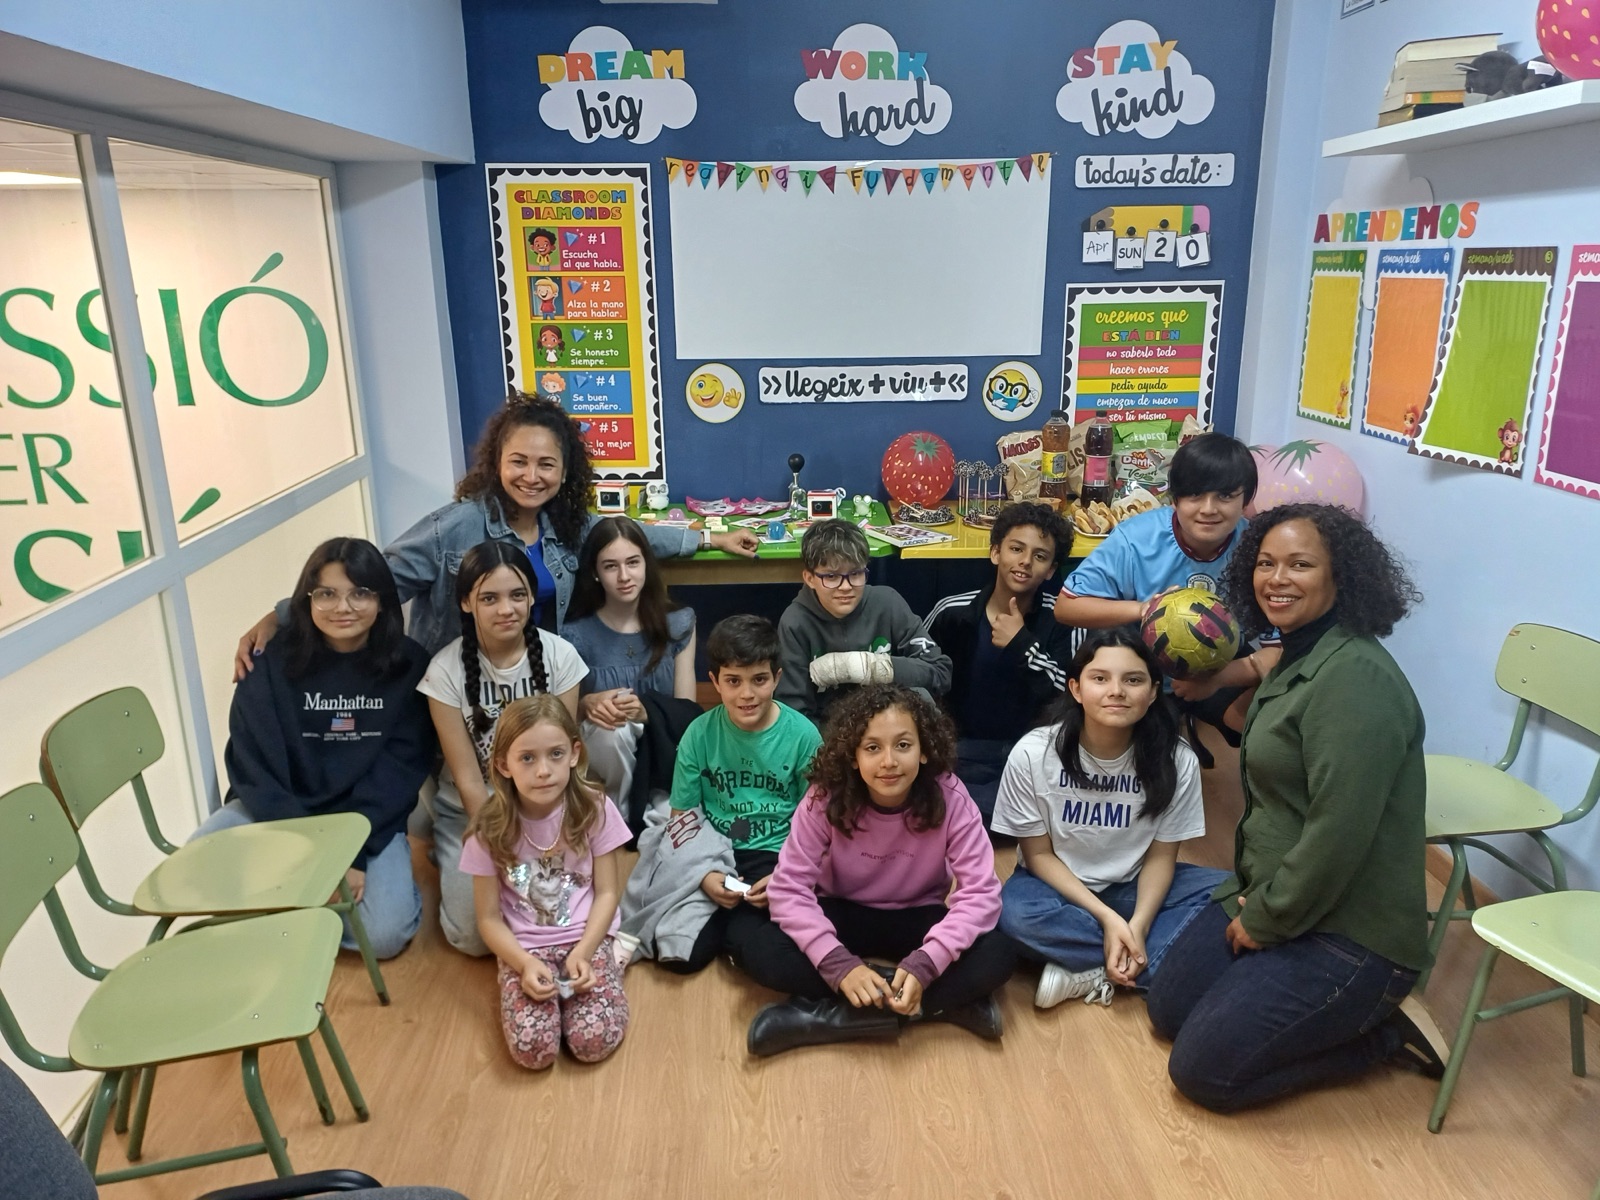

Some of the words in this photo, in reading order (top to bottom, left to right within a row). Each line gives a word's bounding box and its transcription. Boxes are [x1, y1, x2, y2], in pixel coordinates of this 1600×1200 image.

[801, 49, 928, 81] WORK
[1071, 40, 1178, 78] STAY
[537, 50, 685, 84] DREAM
[1091, 66, 1184, 135] kind
[577, 89, 642, 140] big
[838, 77, 935, 142] hard
[667, 162, 788, 188] reading
[1083, 156, 1157, 186] today's
[1160, 154, 1222, 185] date:
[514, 190, 627, 203] CLASSROOM
[521, 206, 622, 220] DIAMONDS
[1313, 201, 1480, 243] APRENDEMOS
[562, 250, 598, 259] Escucha
[1086, 240, 1109, 255] Apr
[1118, 247, 1142, 259] SUN
[1154, 237, 1168, 258] 2
[1185, 239, 1200, 260] 0
[563, 259, 571, 268] al
[575, 261, 589, 270] que
[594, 259, 621, 268] habla.
[567, 300, 587, 308] Alza
[590, 300, 598, 308] la
[567, 311, 588, 319] para
[590, 309, 622, 318] hablar.
[1095, 310, 1155, 324] creemos
[1161, 309, 1189, 329] que
[1102, 329, 1141, 343] ESTÁ
[1145, 329, 1181, 341] BIEN
[570, 349, 582, 357] Se
[585, 348, 619, 357] honesto
[1106, 350, 1117, 358] no
[1120, 347, 1154, 358] saberlo
[1156, 347, 1177, 357] todo
[570, 357, 607, 366] siempre.
[1109, 363, 1136, 375] hacer
[1137, 366, 1170, 375] errores
[785, 370, 865, 403] llegeix
[1111, 379, 1136, 392] pedir
[1137, 379, 1169, 393] ayuda
[573, 394, 584, 402] Se
[587, 394, 608, 402] buen
[1096, 398, 1136, 410] empezar
[1138, 395, 1150, 406] de
[573, 403, 621, 412] compañero.
[1108, 413, 1124, 422] ser
[1125, 410, 1136, 421] tú
[1138, 411, 1167, 421] mismo
[596, 440, 604, 448] lo
[607, 440, 632, 450] mejor
[1067, 444, 1086, 471] LIS
[303, 692, 384, 711] Manhattan
[741, 757, 753, 768] THE
[730, 801, 754, 814] NOT
[760, 802, 779, 812] MY
[1062, 799, 1131, 828] MIAMI
